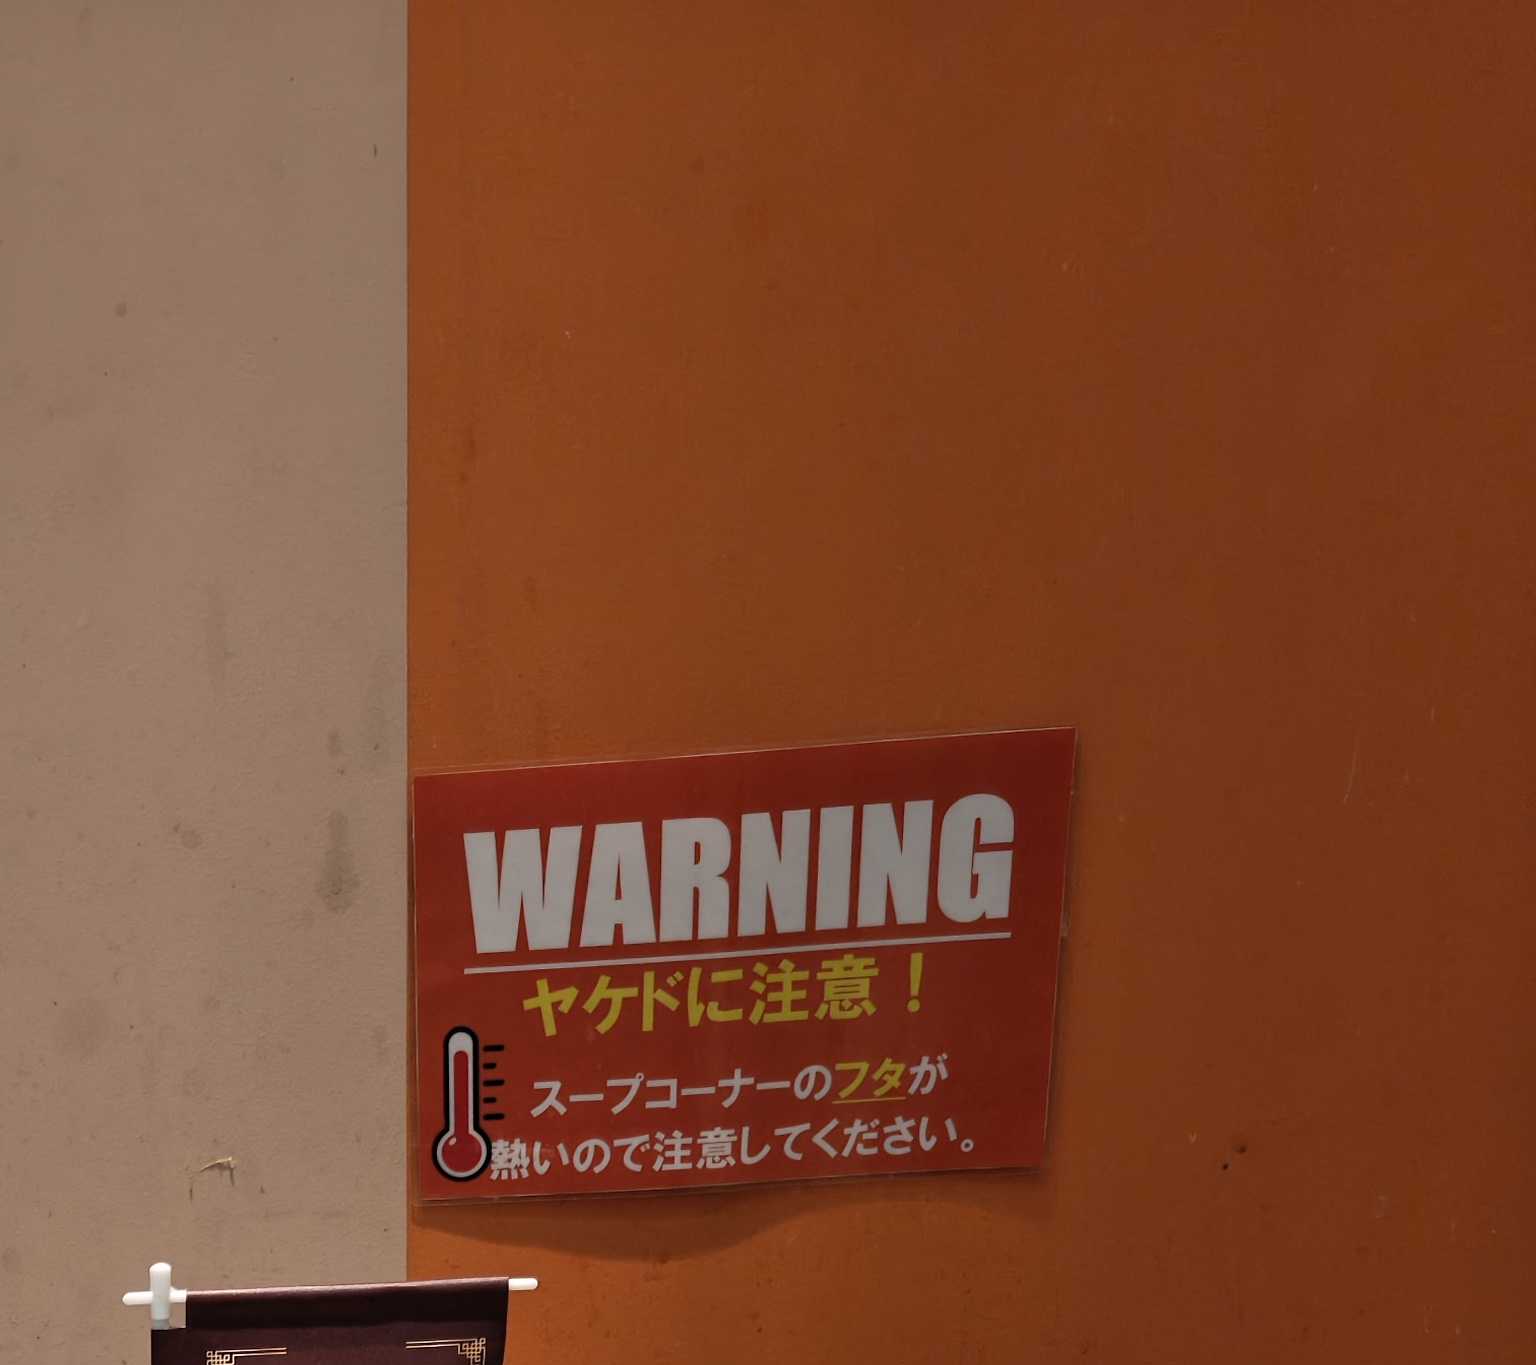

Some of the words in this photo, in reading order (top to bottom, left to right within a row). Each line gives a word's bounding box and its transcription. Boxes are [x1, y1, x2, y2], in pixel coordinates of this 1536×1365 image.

[464, 794, 1015, 954] WARNING
[523, 952, 925, 1037] ヤケドに注意！
[530, 1053, 950, 1118] スープコーナーのフタが
[489, 1115, 975, 1181] 熱いので注意してください。
